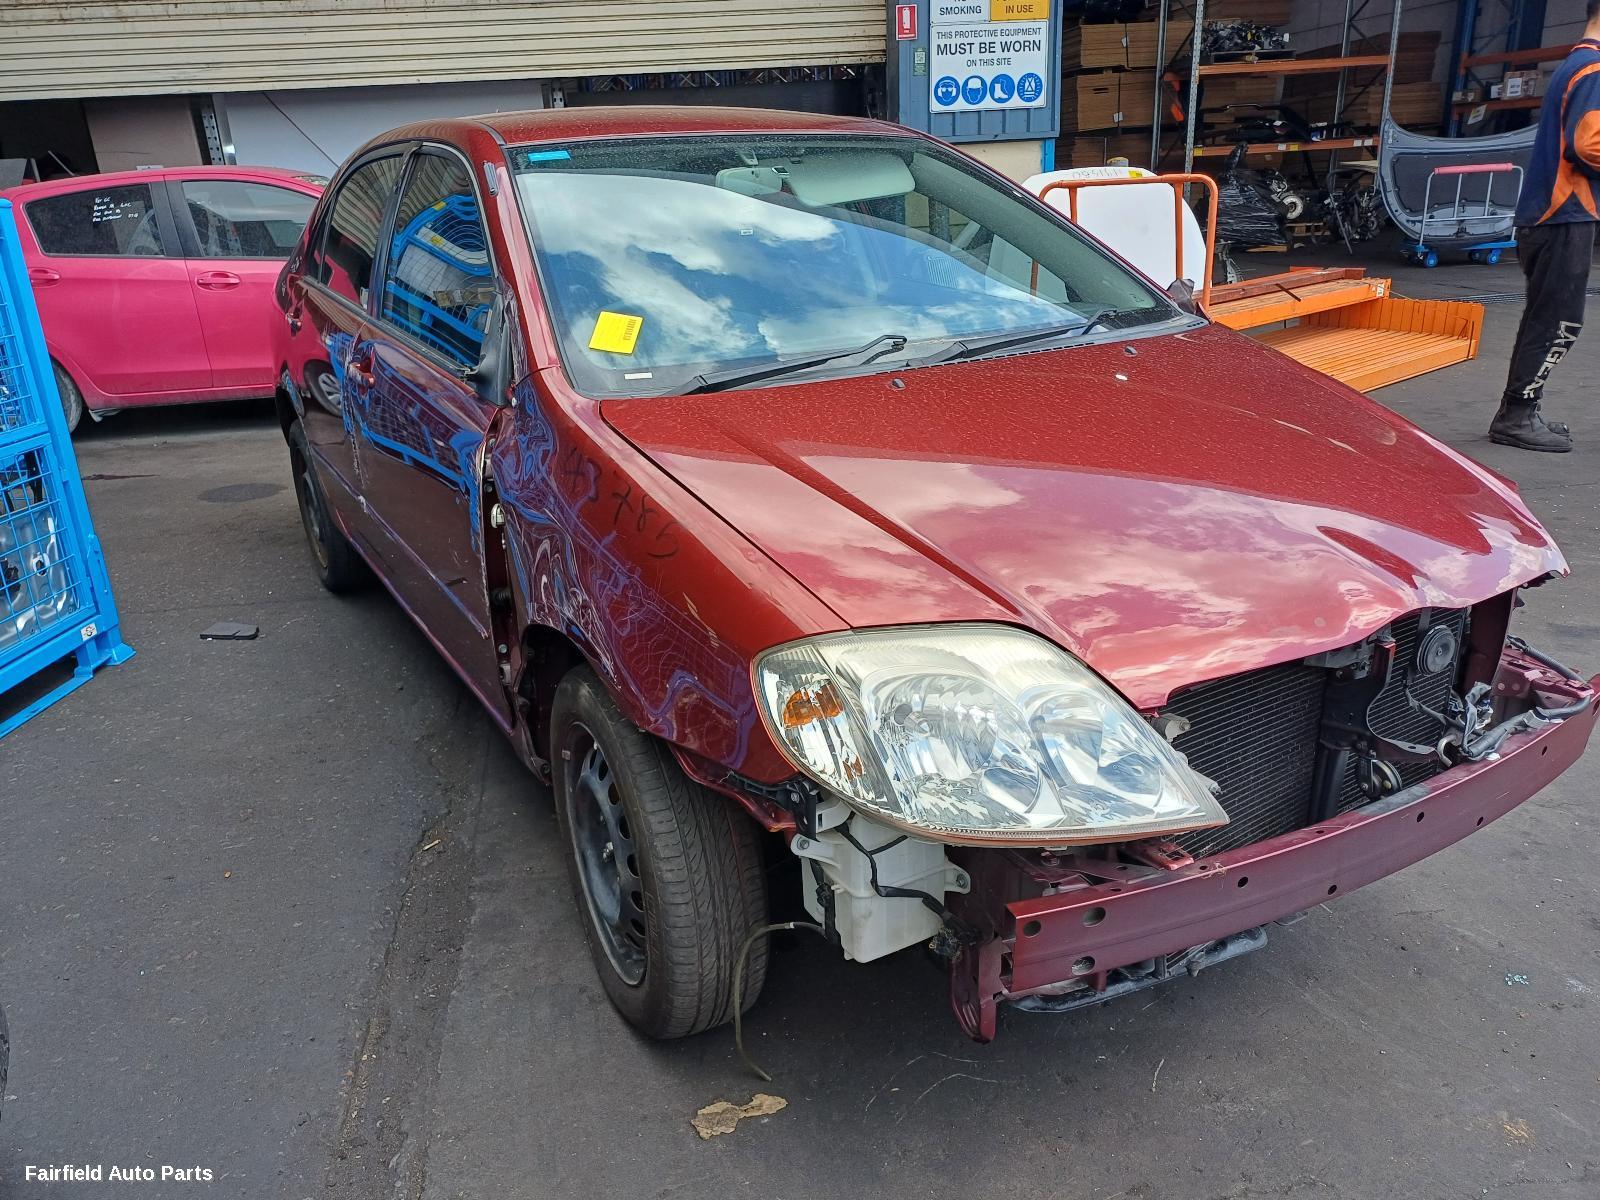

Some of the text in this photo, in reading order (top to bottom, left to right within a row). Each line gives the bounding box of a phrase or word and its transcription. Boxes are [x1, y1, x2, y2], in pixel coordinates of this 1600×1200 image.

[939, 5, 982, 16] SMOKING
[1005, 4, 1034, 14] IN USE
[936, 27, 1042, 40] THIS PROTECTIVE EQUIPMENT
[936, 39, 1041, 56] MUST BE WORN
[966, 57, 1012, 68] ON THIS SITE
